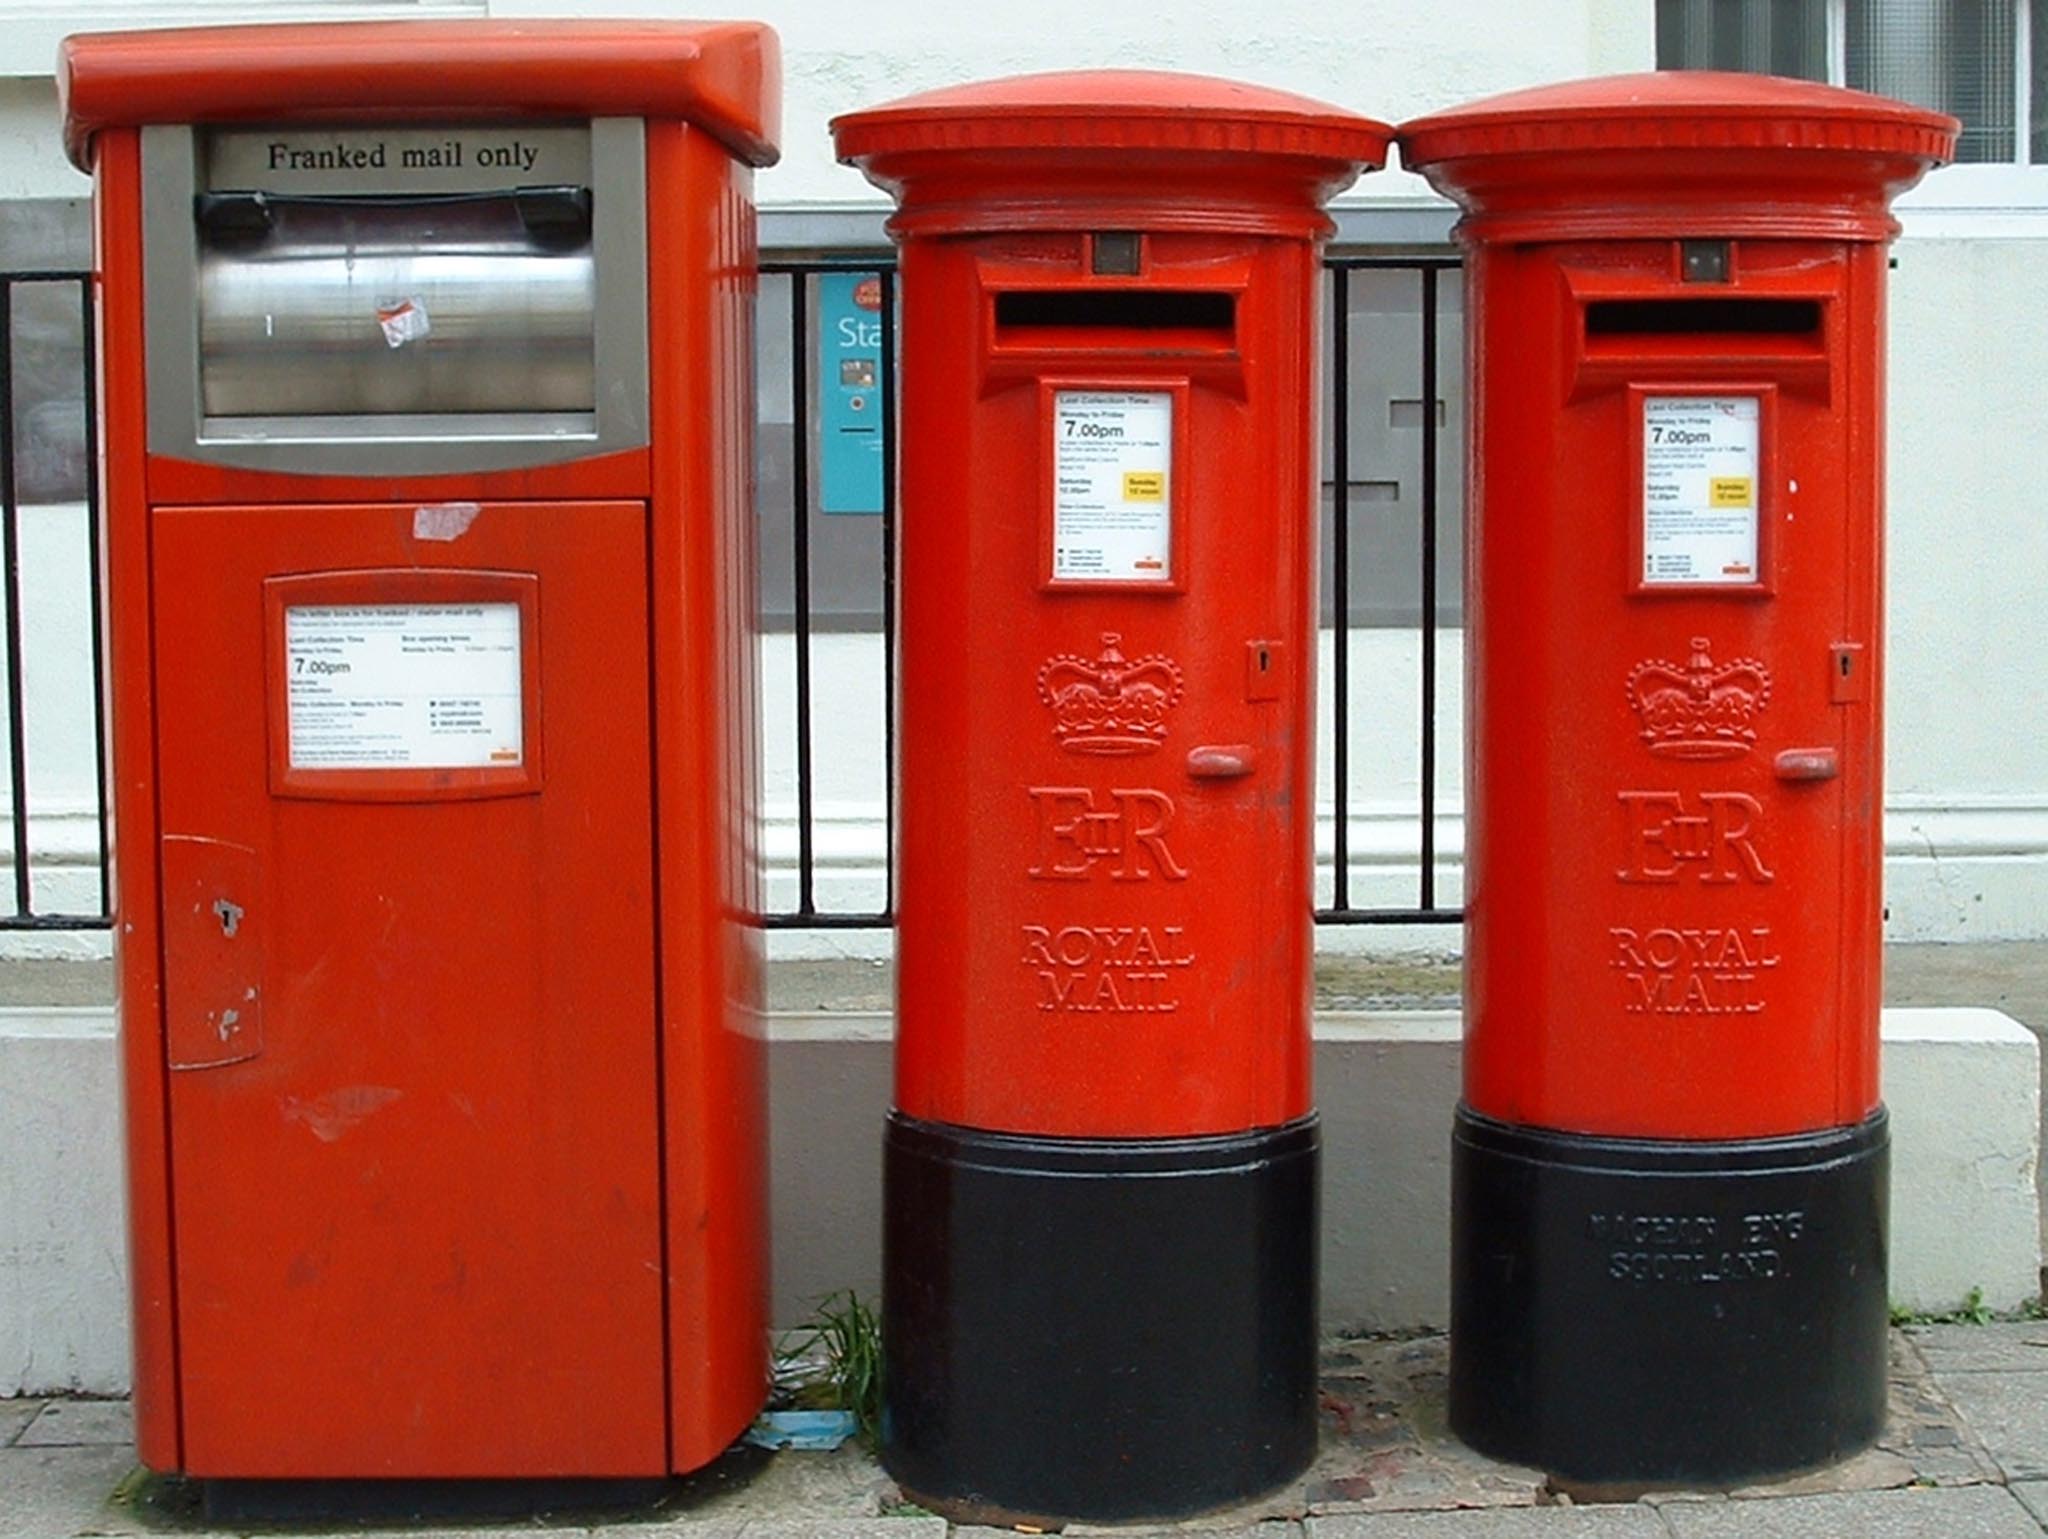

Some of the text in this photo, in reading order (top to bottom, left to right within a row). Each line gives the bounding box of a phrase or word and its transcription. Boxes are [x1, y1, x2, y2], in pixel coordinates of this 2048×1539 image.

[268, 141, 539, 171] Franked mail only
[837, 316, 882, 348] Sta
[1064, 420, 1124, 439] 7.00pm
[1651, 426, 1711, 445] 7.00pm
[293, 657, 352, 676] 7.00pm
[1020, 924, 1196, 967] ROYAL
[1608, 926, 1781, 968] ROYAL
[1035, 969, 1180, 1013] MAIL
[1624, 972, 1767, 1014] MAIL
